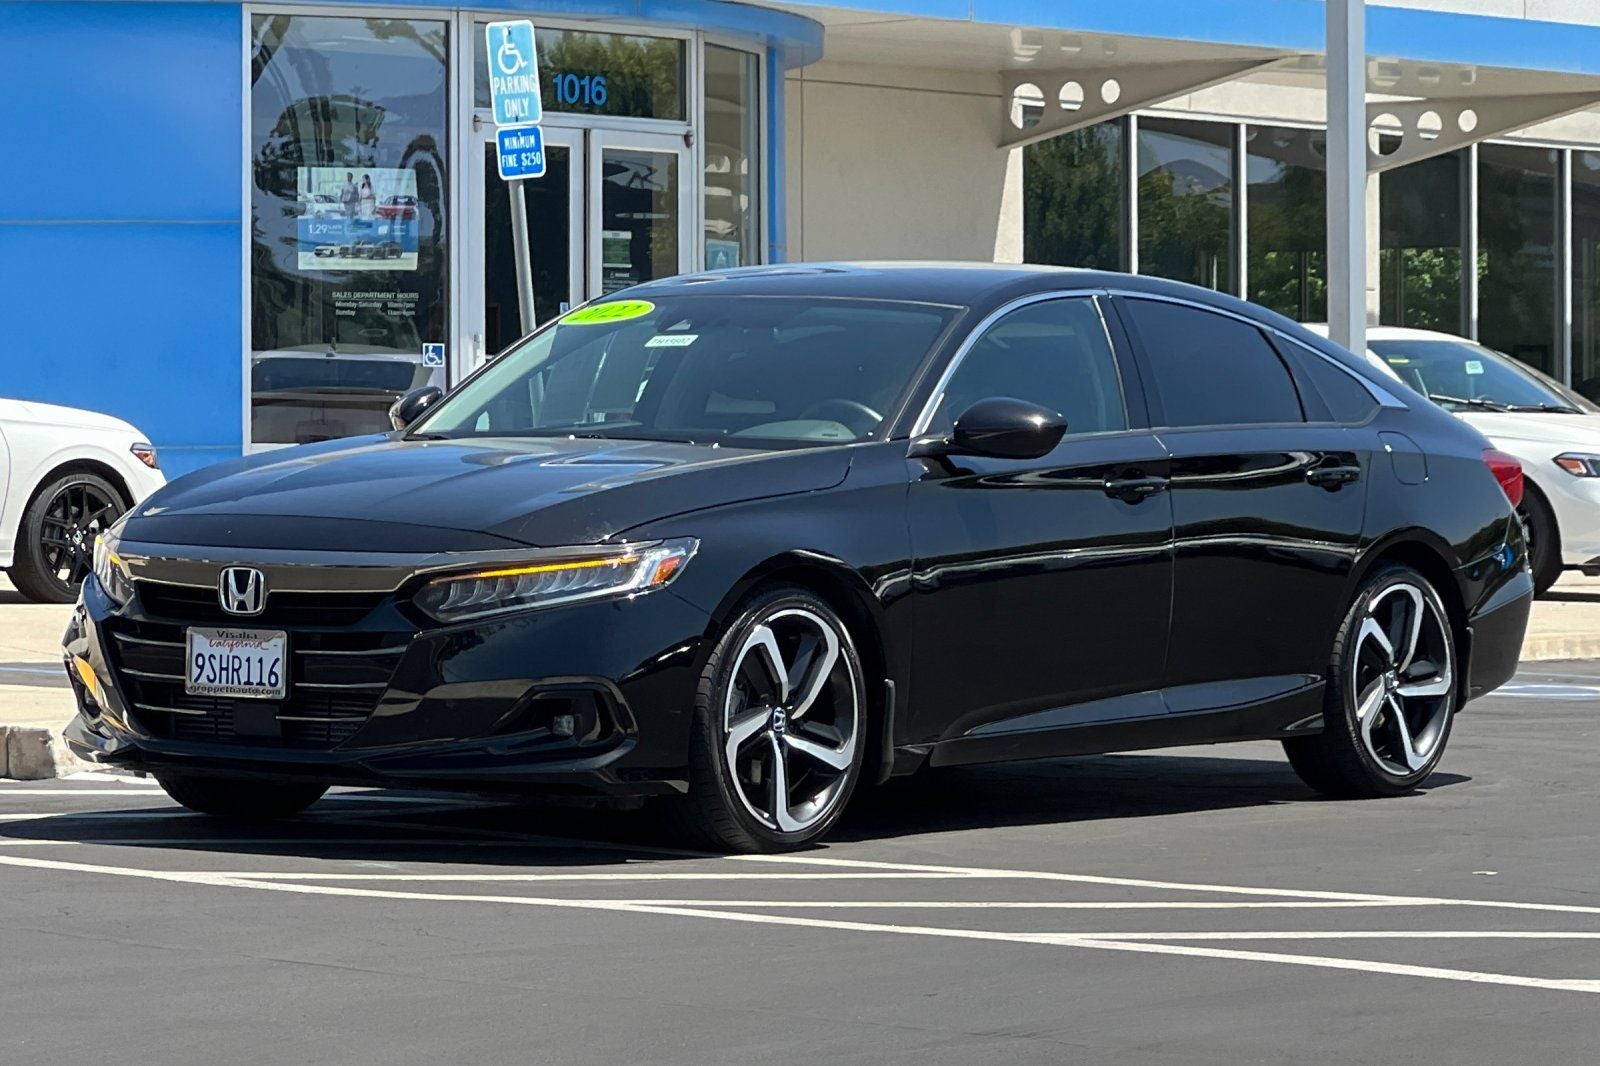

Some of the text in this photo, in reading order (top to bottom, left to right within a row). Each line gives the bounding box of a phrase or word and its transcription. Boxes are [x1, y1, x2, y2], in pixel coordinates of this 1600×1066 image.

[493, 74, 537, 95] PARKING
[553, 74, 607, 106] 1016
[504, 98, 529, 118] ONLY
[504, 134, 536, 150] MINIMUM
[502, 152, 542, 168] FINE $250
[353, 291, 395, 299] DEPARTMENT
[216, 630, 258, 640] Visalia
[209, 639, 269, 653] California
[194, 652, 280, 688] 9SHR116
